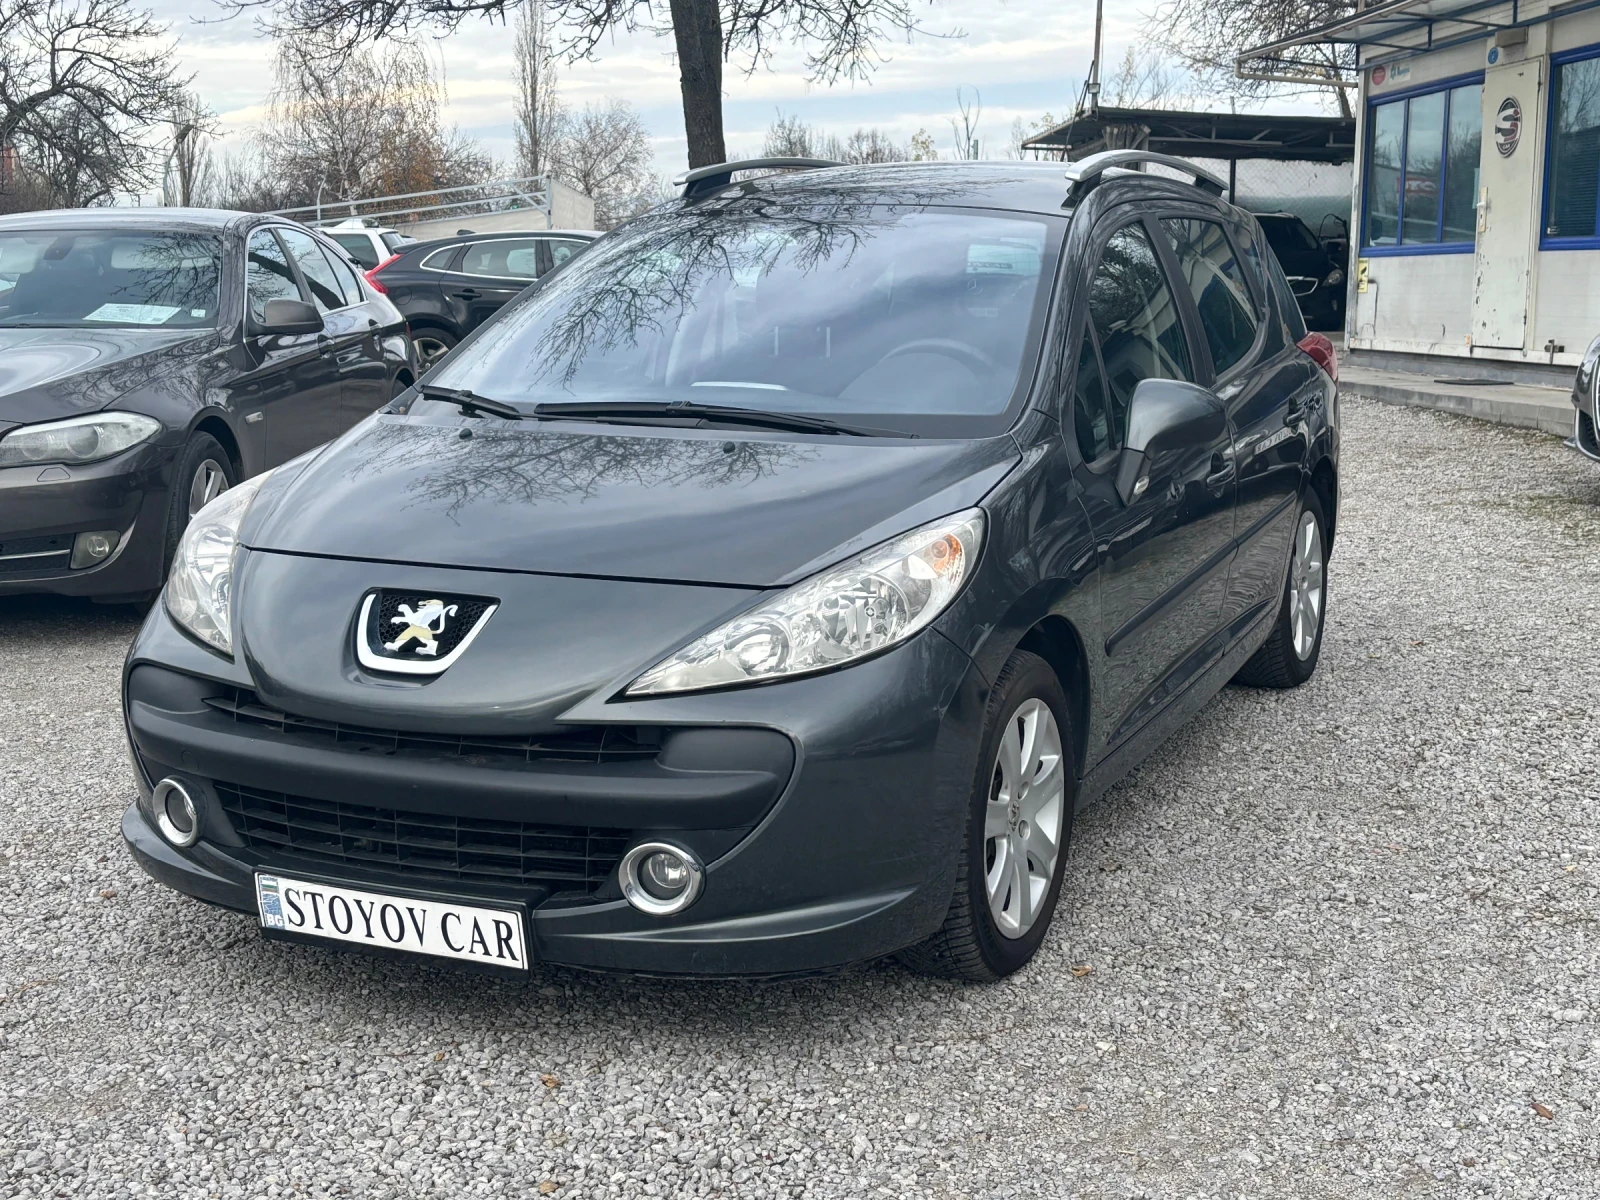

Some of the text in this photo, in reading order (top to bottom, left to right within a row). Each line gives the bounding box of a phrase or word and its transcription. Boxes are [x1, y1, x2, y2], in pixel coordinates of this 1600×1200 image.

[267, 913, 284, 927] BG
[284, 887, 519, 962] STOYOV CAR
